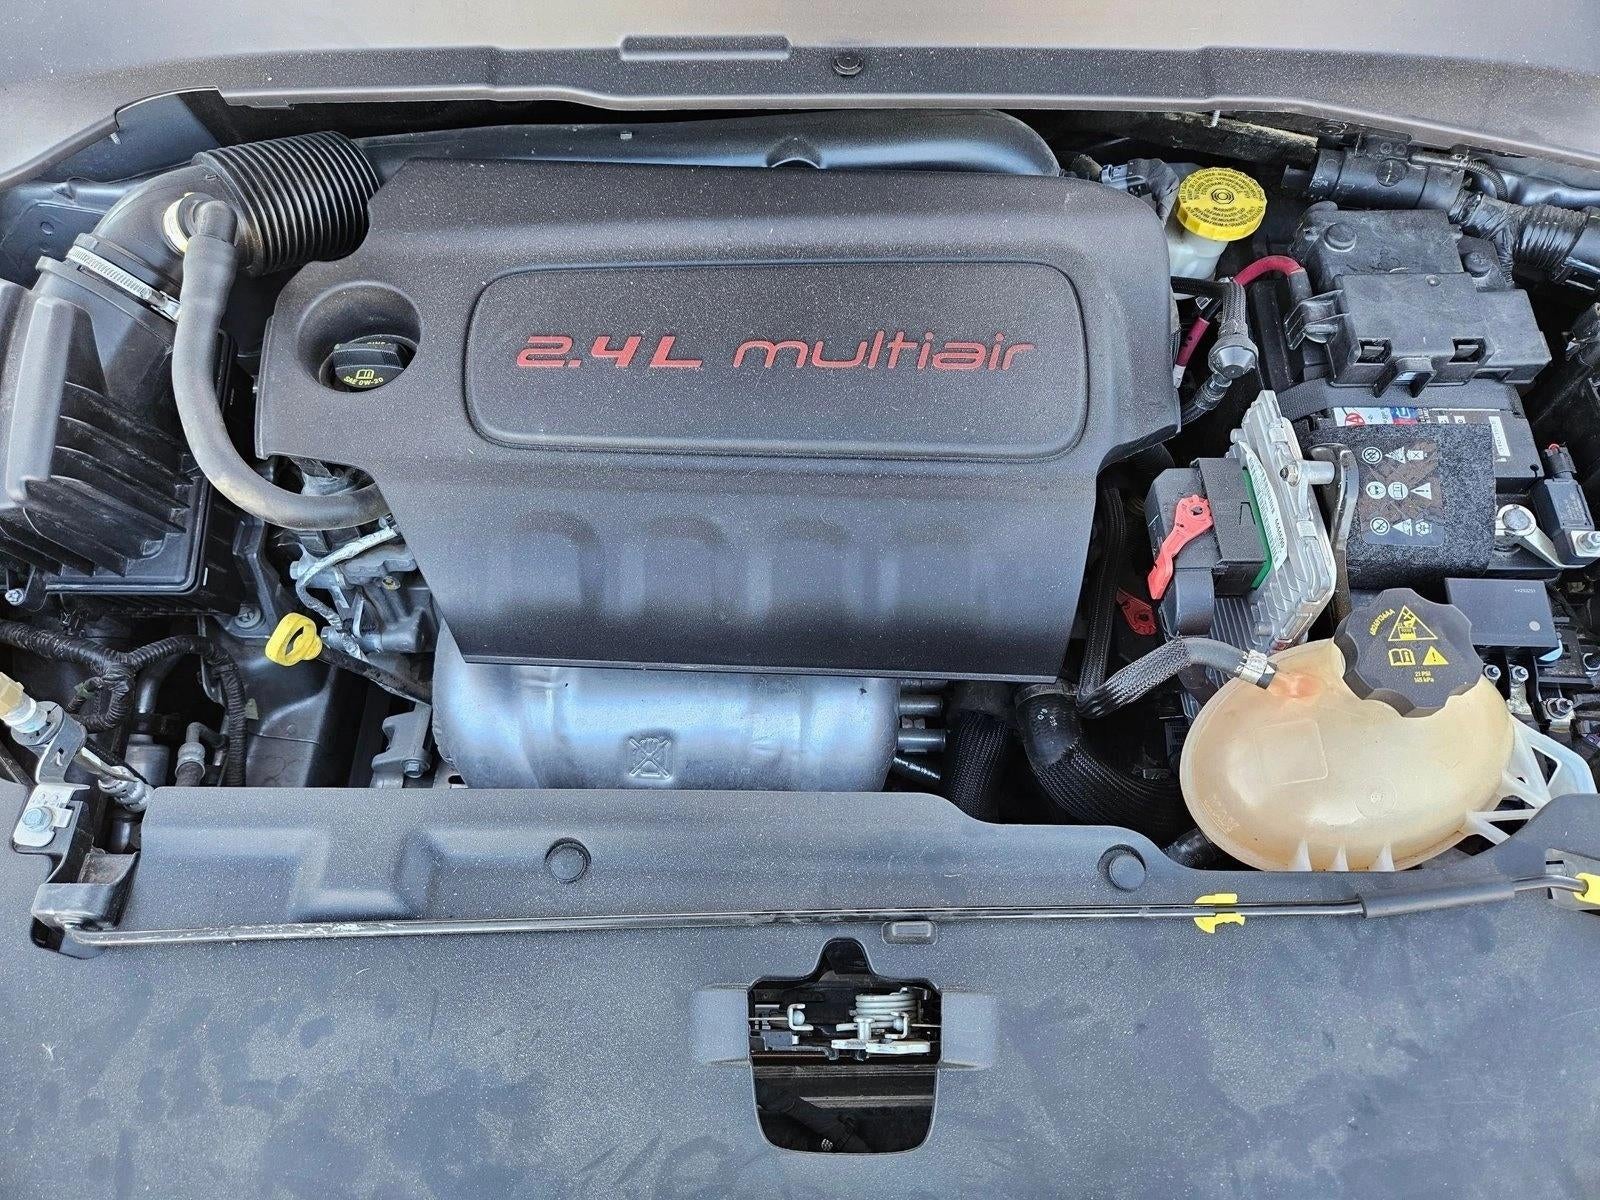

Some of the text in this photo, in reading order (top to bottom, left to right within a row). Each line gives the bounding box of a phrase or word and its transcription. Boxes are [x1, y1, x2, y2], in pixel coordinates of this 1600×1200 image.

[733, 330, 1036, 372] multiair
[343, 376, 384, 386] SAE 0W-20
